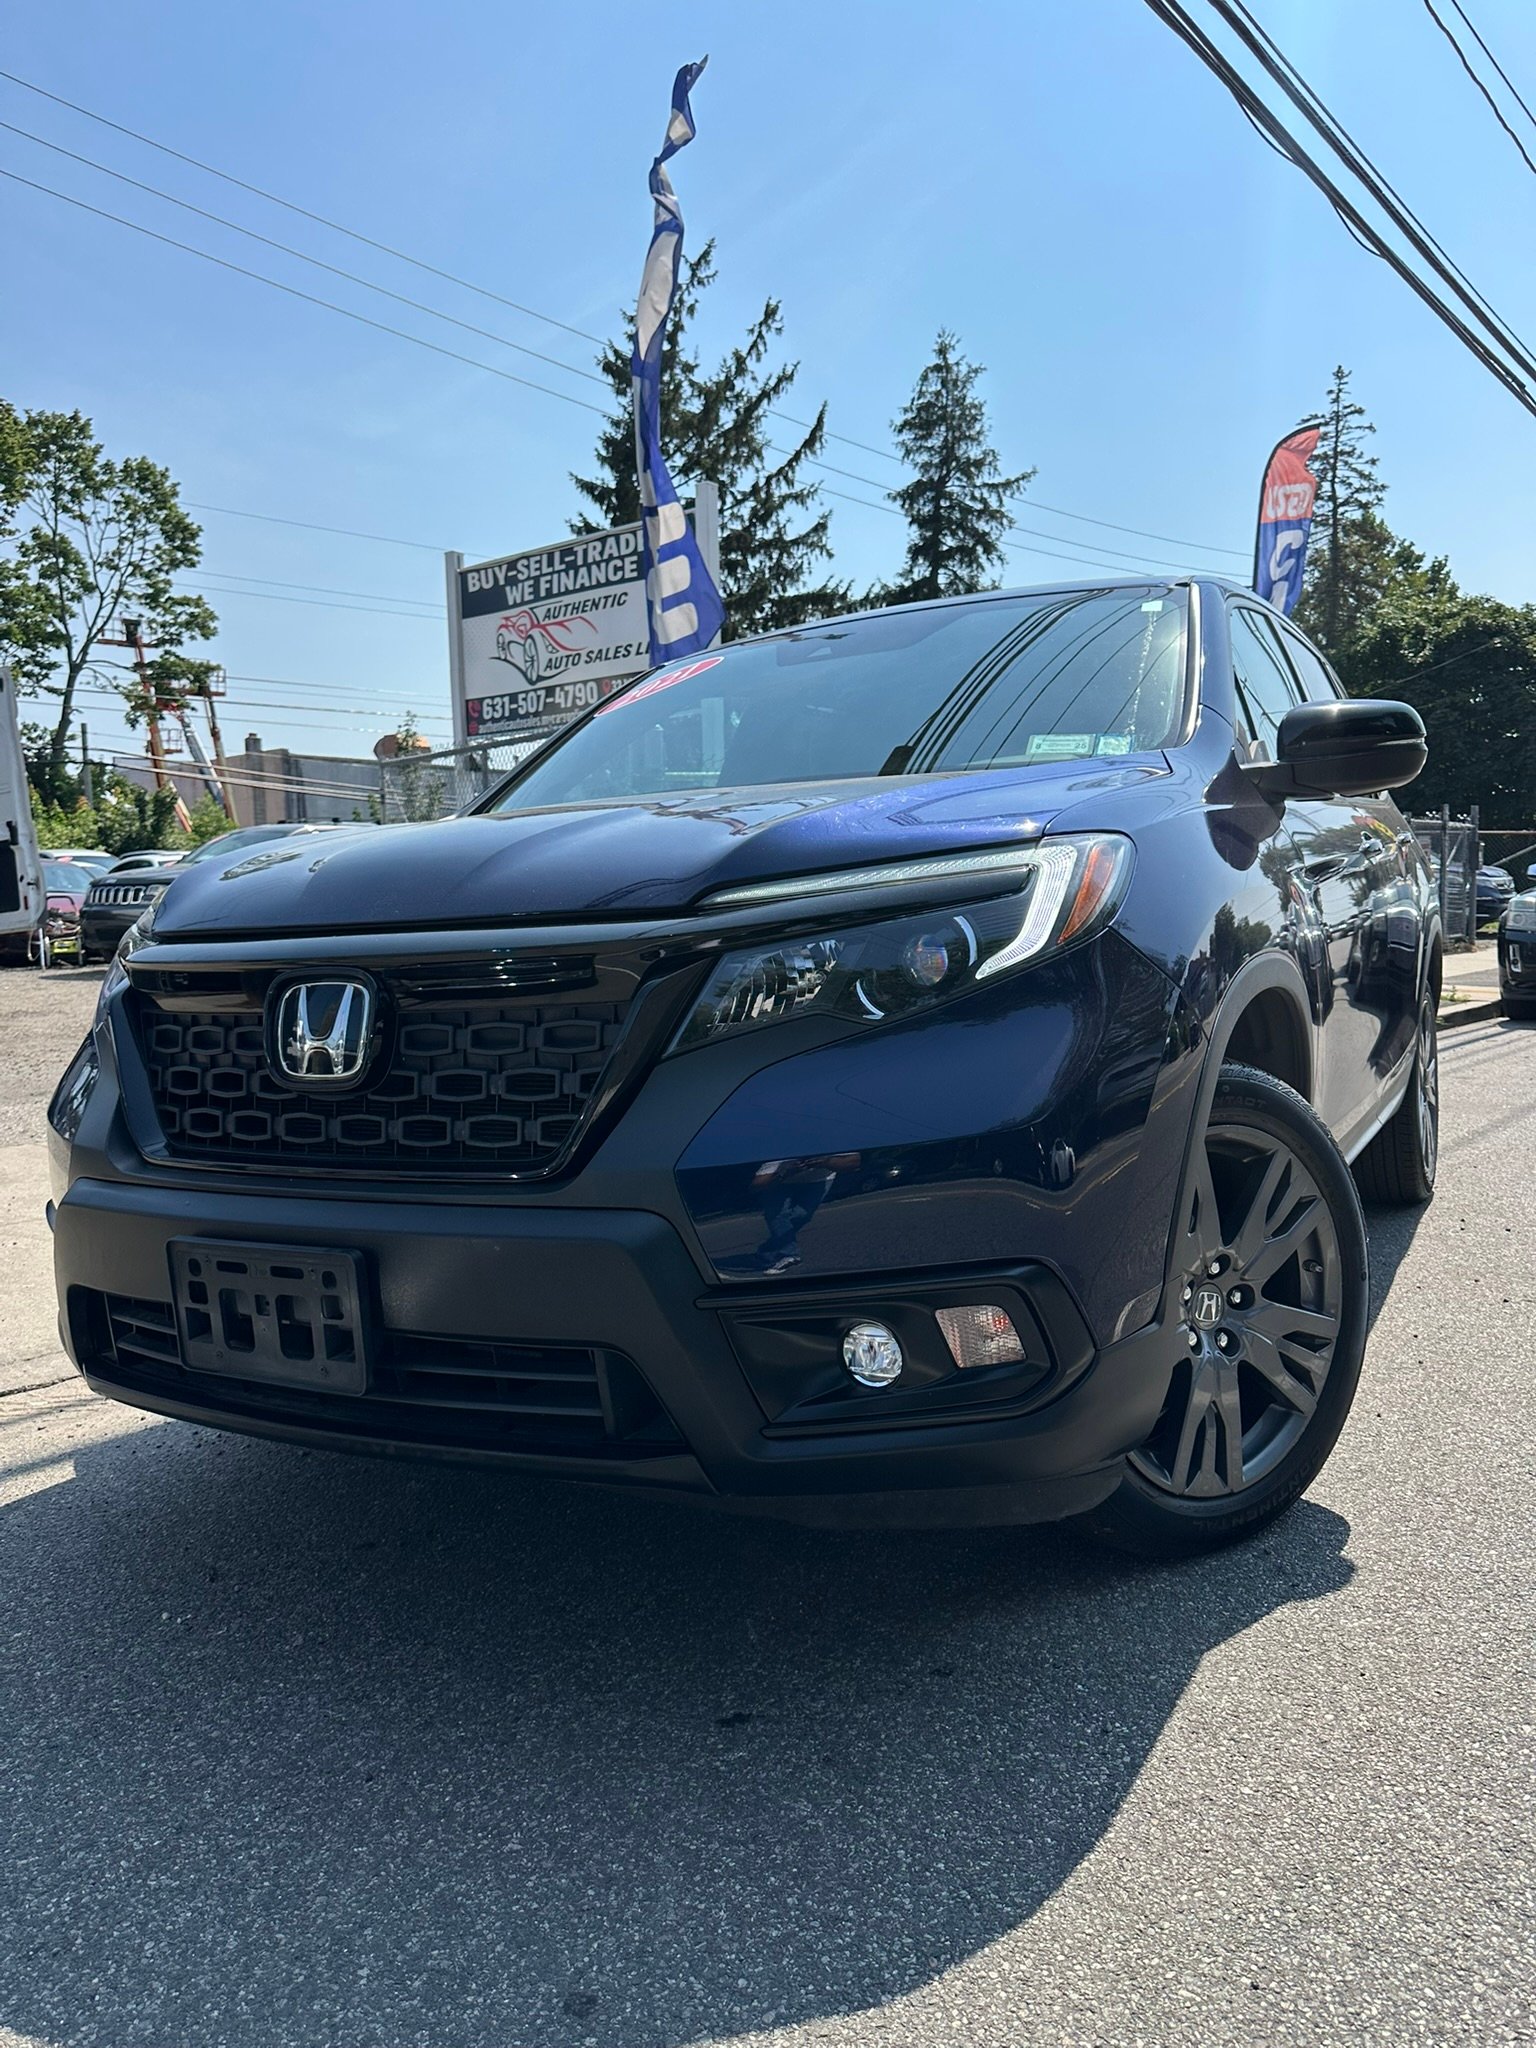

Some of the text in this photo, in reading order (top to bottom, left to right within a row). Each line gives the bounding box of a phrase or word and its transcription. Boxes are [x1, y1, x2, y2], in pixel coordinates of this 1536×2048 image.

[504, 555, 639, 606] WE FINANCE
[542, 591, 629, 622] AUTHENTIC
[543, 652, 581, 673] AUTO
[584, 642, 633, 665] SALES
[482, 681, 599, 720] 631-507-4790
